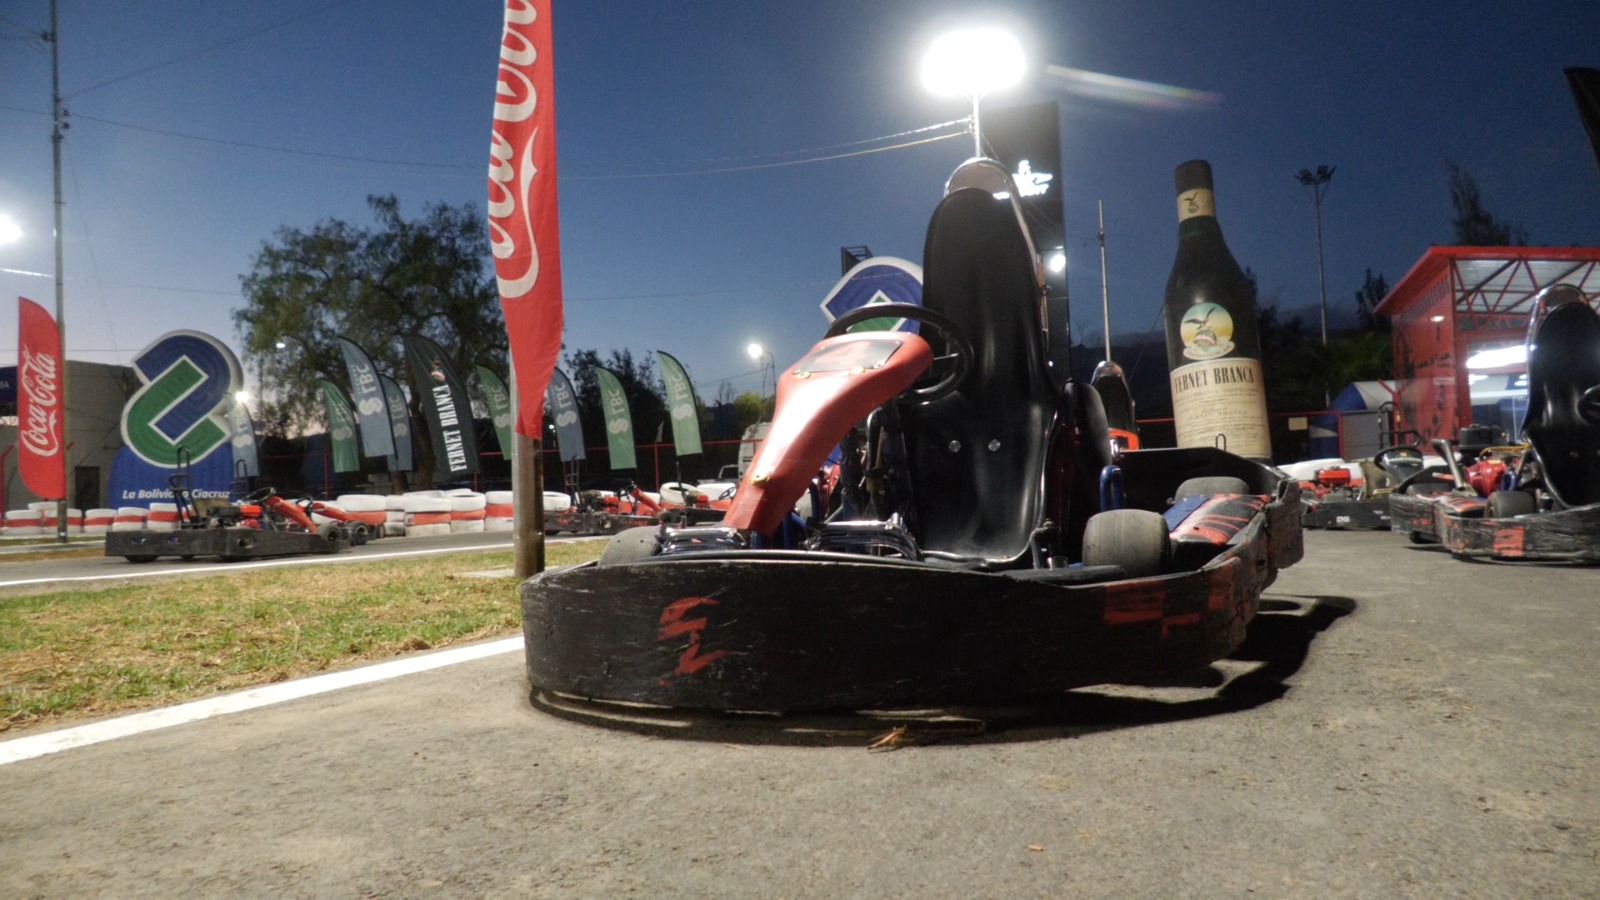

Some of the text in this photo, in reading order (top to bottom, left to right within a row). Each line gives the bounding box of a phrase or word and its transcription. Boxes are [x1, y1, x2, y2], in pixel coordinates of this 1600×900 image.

[20, 342, 59, 457] Coca-Cola
[1173, 366, 1255, 394] FERNET BRANCA
[432, 384, 468, 473] FERNET BRANCA
[122, 489, 231, 500] La Boliviaa Ciacruz
